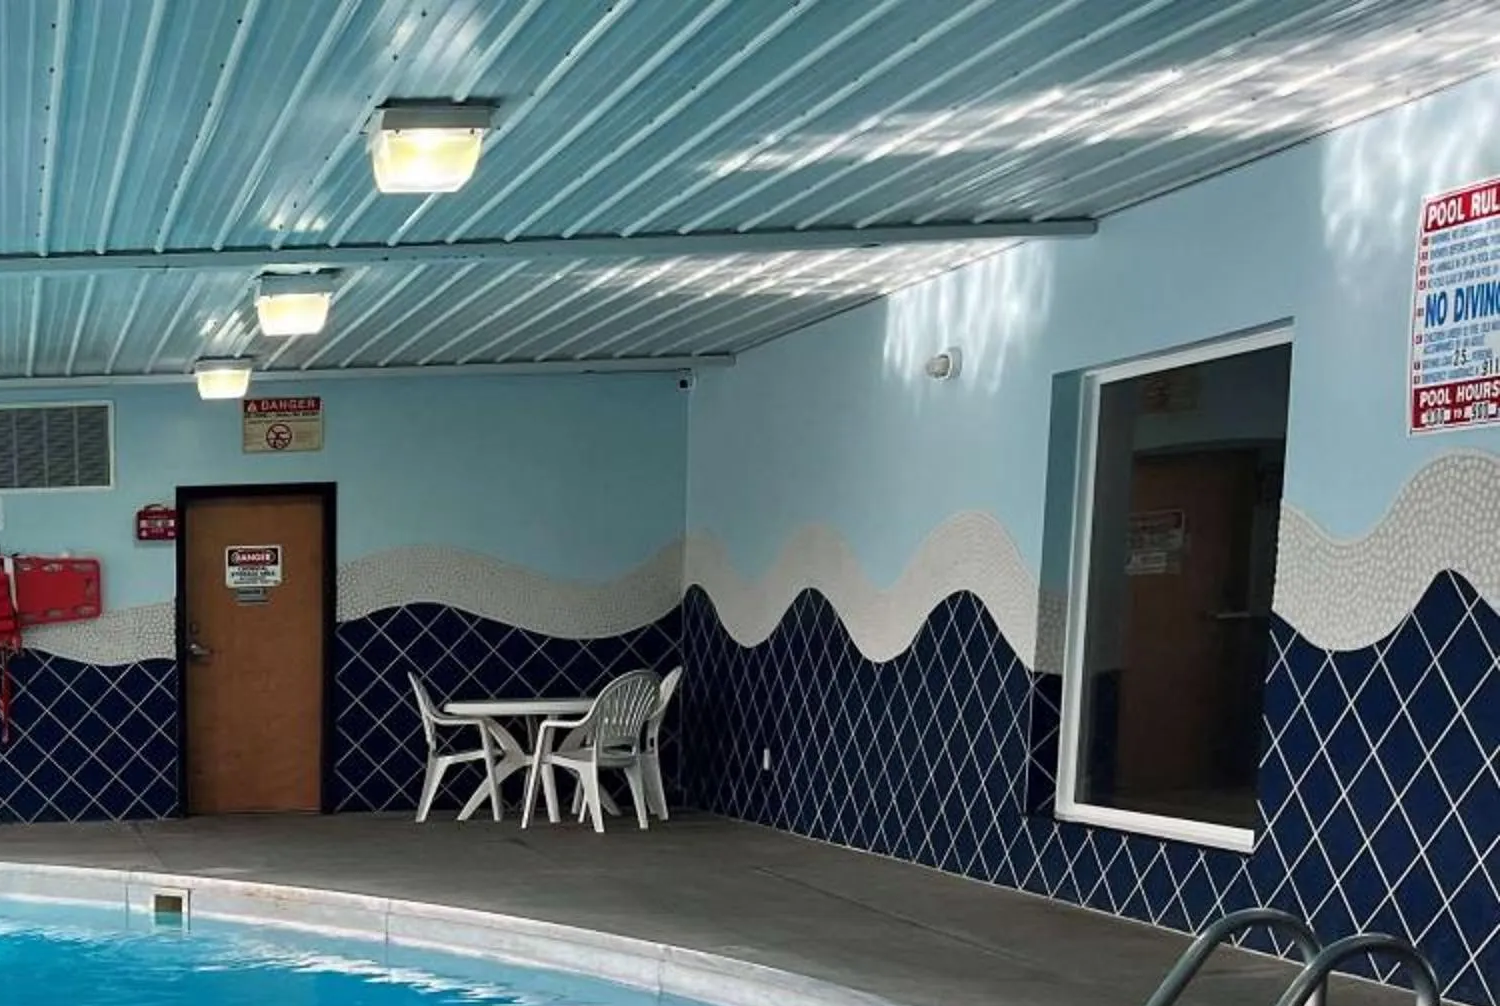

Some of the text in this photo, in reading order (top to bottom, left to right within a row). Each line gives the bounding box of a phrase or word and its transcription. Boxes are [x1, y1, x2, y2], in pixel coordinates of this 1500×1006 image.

[1427, 197, 1465, 229] POOL
[1425, 291, 1448, 328] NO
[261, 399, 316, 411] DANGER
[1419, 380, 1500, 409] POOL HOURS
